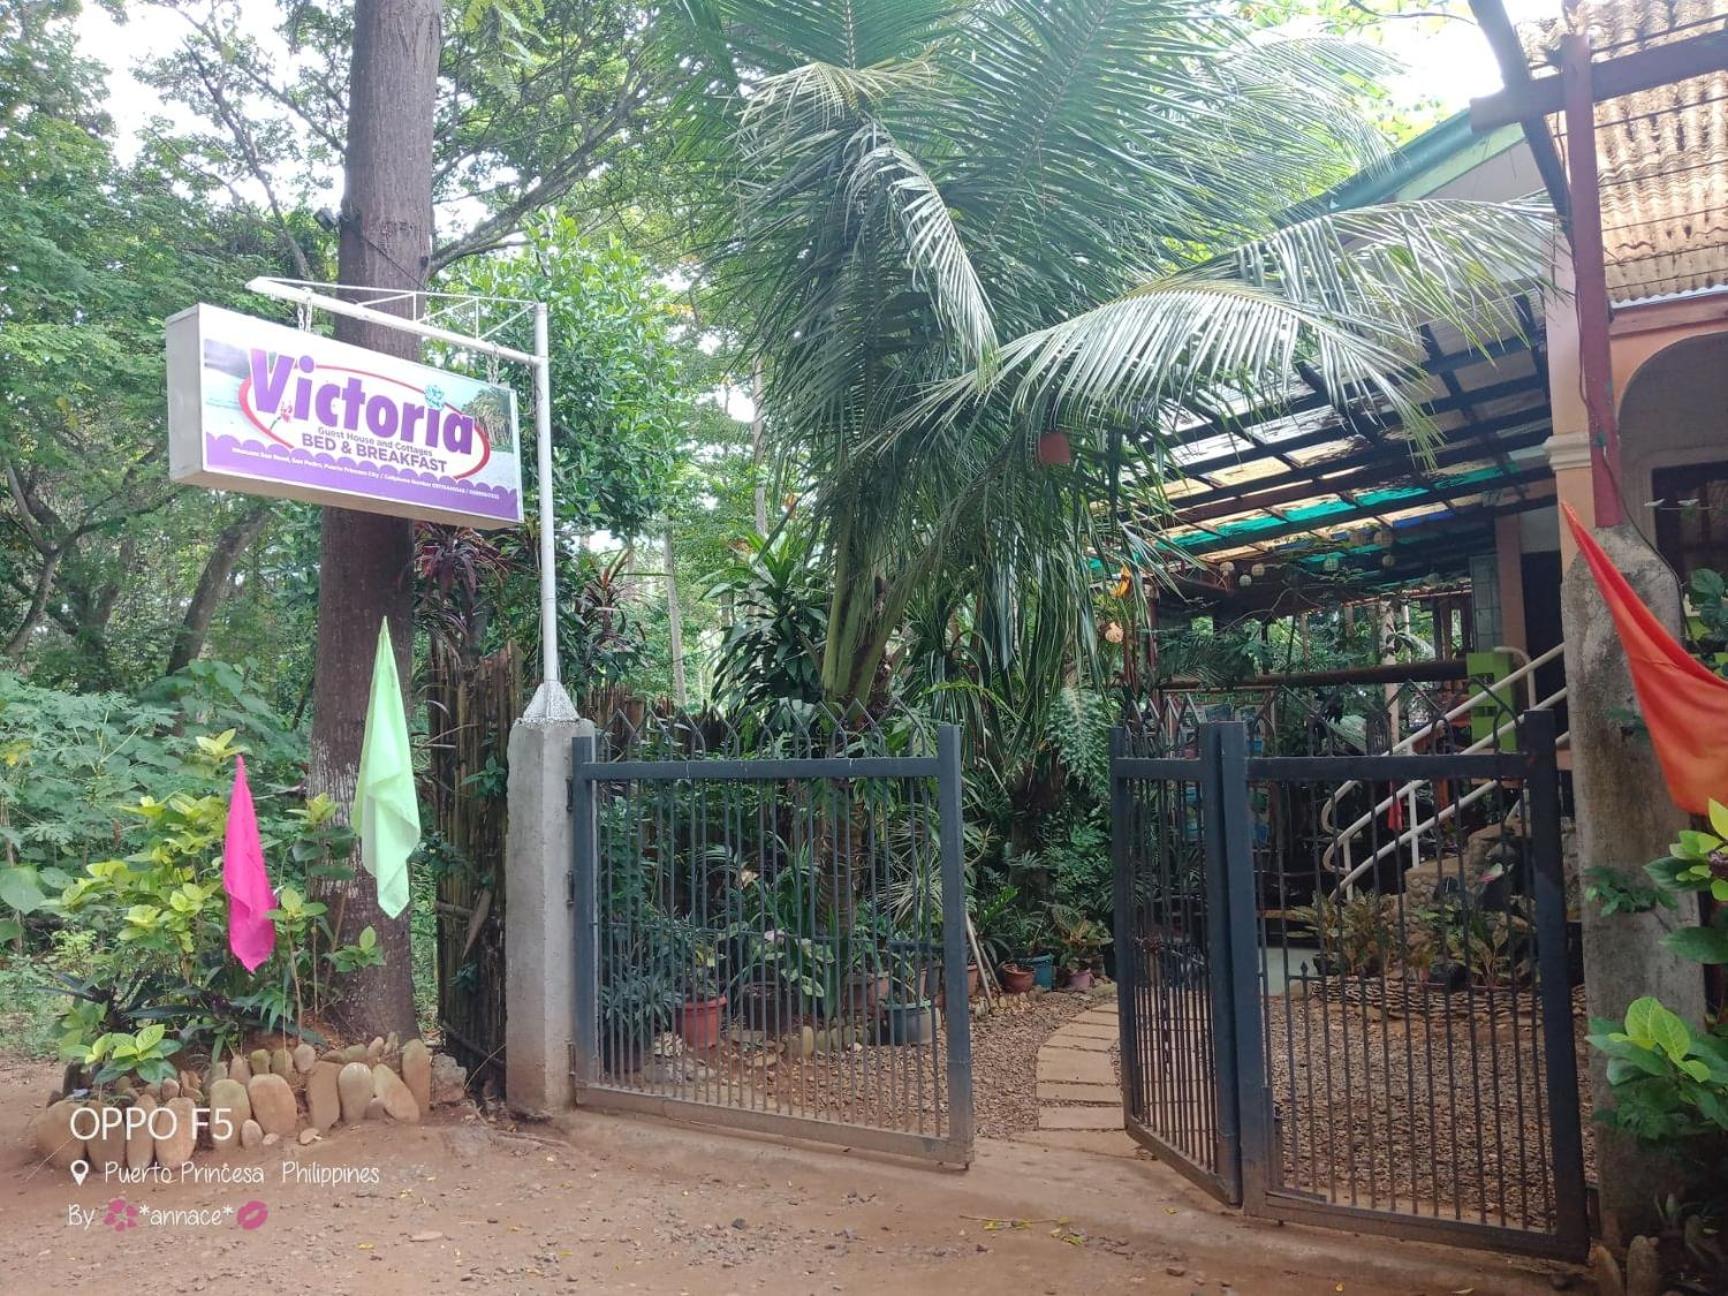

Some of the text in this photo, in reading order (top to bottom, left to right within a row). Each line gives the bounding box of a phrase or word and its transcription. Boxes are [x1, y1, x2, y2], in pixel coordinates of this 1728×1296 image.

[250, 348, 474, 456] Victoria
[301, 433, 447, 473] BED & BREAKFAST
[317, 426, 433, 457] Guest House and Cottages
